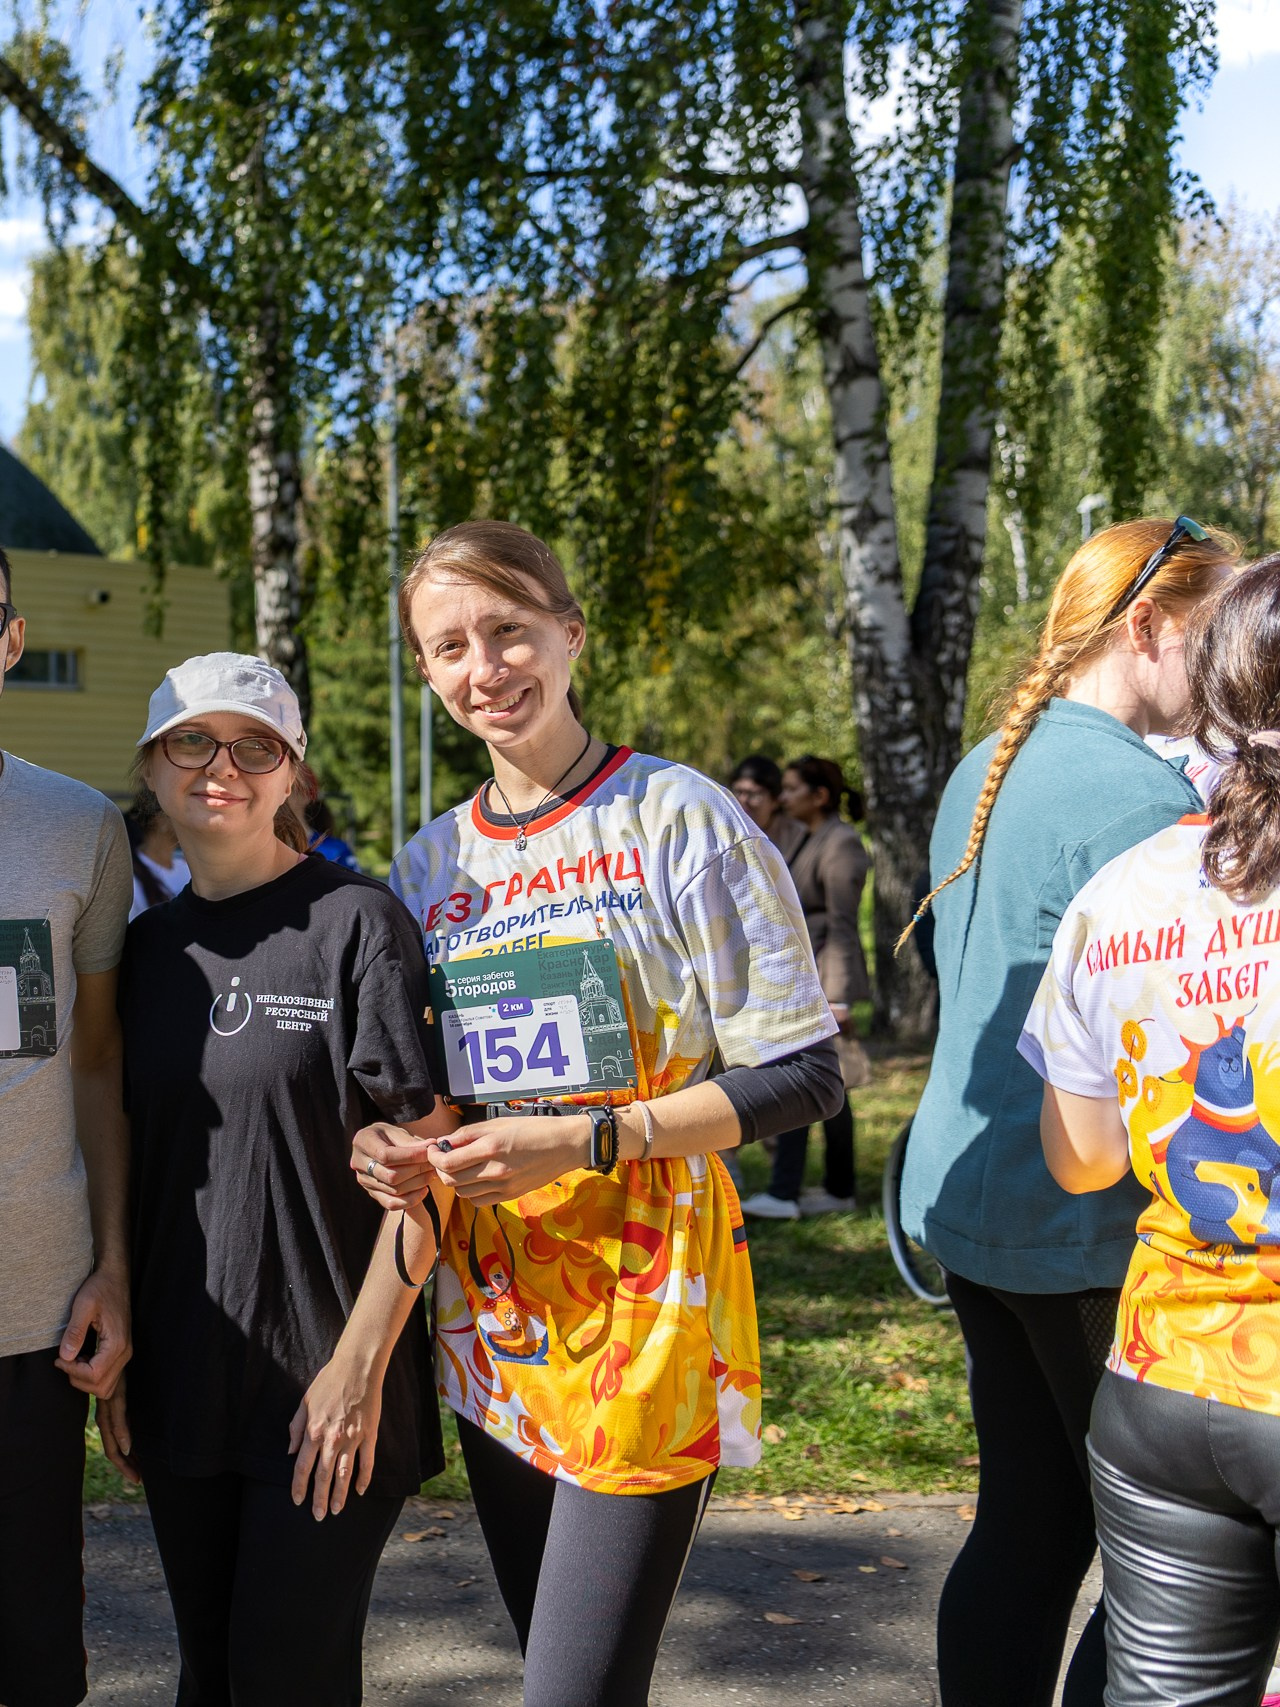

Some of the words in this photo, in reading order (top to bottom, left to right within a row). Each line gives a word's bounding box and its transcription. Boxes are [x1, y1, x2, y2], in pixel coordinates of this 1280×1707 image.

[421, 892, 472, 932] ЕЗ
[481, 848, 645, 914] ГРАНИЦ
[1086, 917, 1186, 977] САМЫЙ
[457, 973, 481, 985] серия
[482, 969, 515, 981] забегов
[1175, 960, 1269, 1009] ЗАБЕГ
[445, 979, 458, 998] 5
[458, 979, 517, 998] городов
[255, 994, 335, 1010] ИНКЛЮЗИВНЫЙ
[503, 1003, 510, 1012] 2
[265, 1007, 329, 1022] РЕСУРСНЫЙ
[276, 1020, 312, 1032] ЦЕНТР
[458, 1022, 570, 1085] 154
